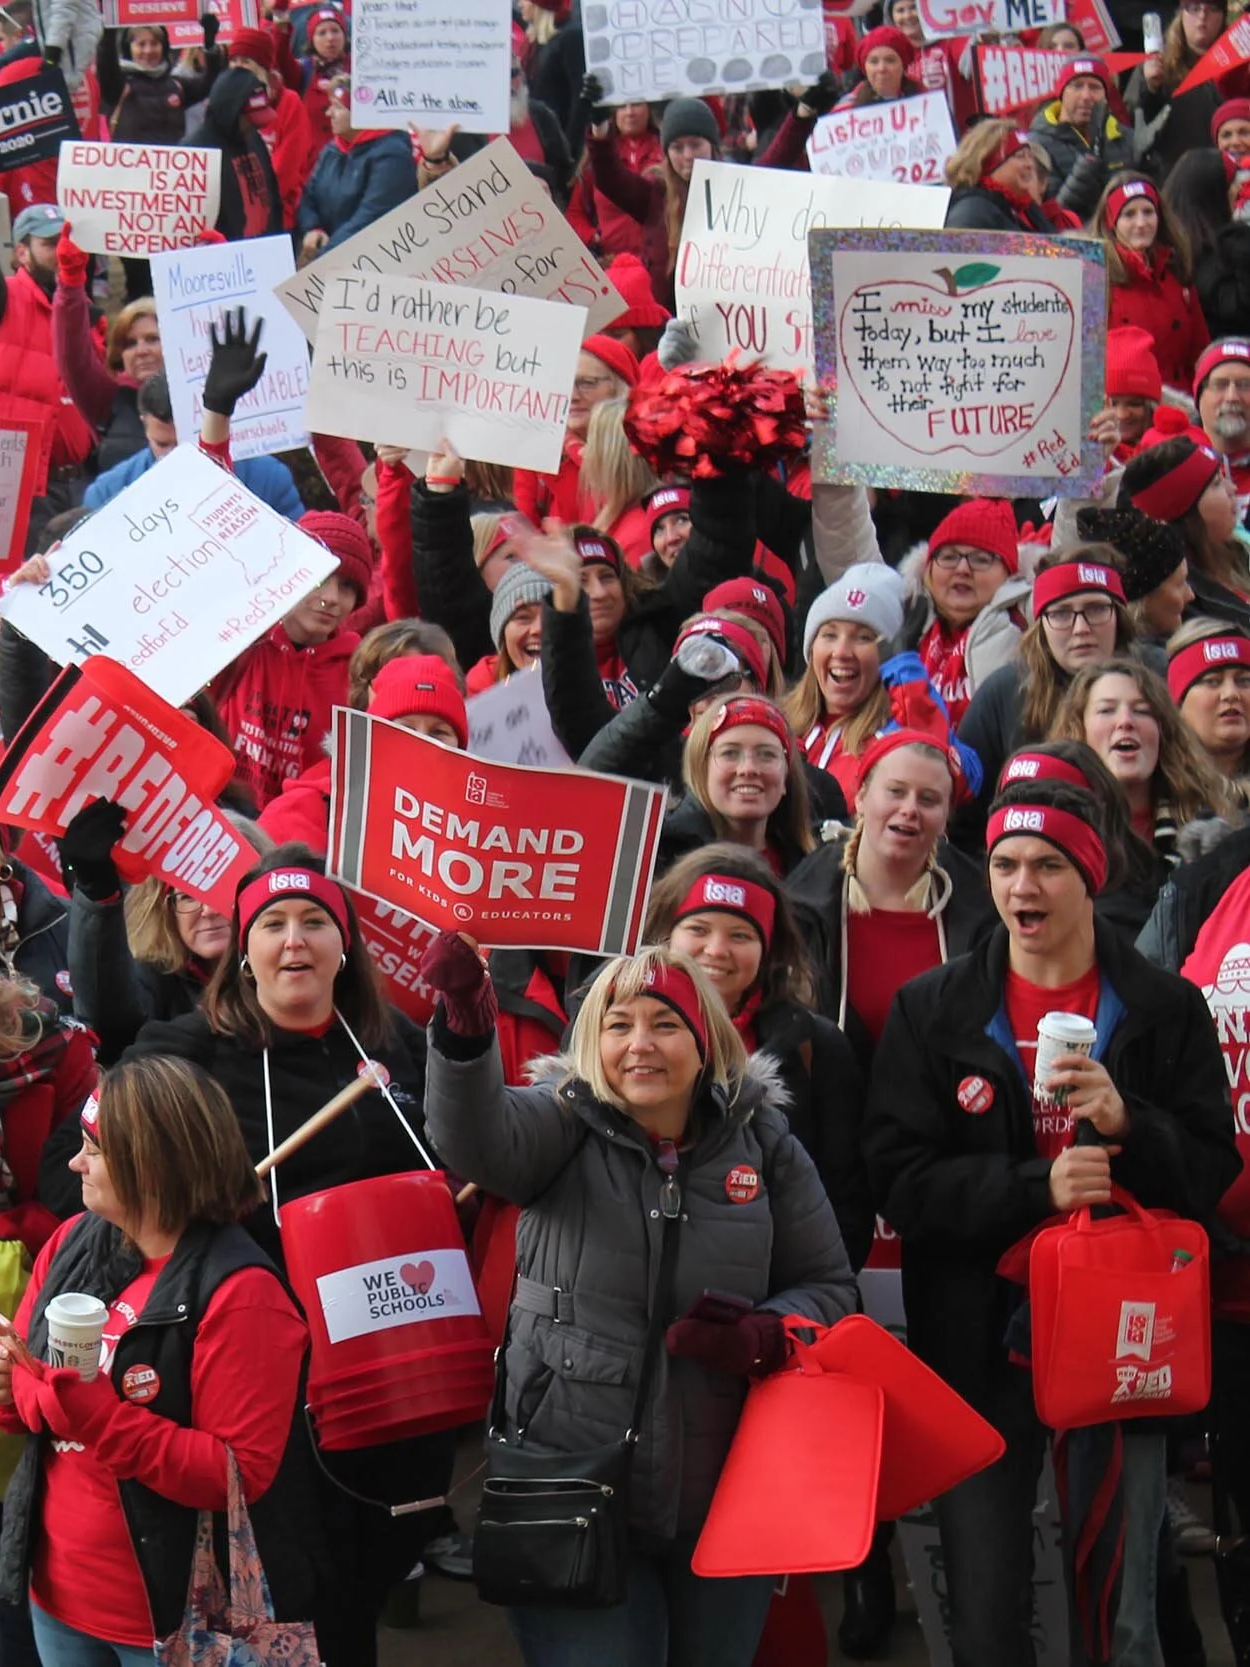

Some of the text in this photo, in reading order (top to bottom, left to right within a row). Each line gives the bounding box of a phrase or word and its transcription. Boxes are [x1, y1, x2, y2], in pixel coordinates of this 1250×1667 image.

[72, 146, 207, 171] EDUCATION
[150, 171, 207, 192] IS AN
[64, 188, 207, 213] INVESTMENT
[705, 178, 769, 250] Why
[118, 212, 207, 233] NOT AN
[168, 252, 257, 298] Mooresville
[514, 246, 565, 283] for
[332, 278, 512, 336] I'd rather be
[852, 291, 881, 313] I
[889, 297, 953, 318] miss
[961, 299, 995, 324] my
[715, 302, 767, 353] YOU
[853, 315, 1058, 351] today, but I love
[336, 322, 542, 377] TEACHING but
[858, 346, 1045, 371] them too much
[327, 354, 569, 425] this is IMPORTANT!
[870, 371, 1026, 402] to not fight for
[887, 393, 935, 414] their
[927, 402, 1035, 438] FUTURE
[123, 497, 180, 543] days
[202, 492, 243, 529] STUDENTS
[217, 505, 260, 541] REASON
[37, 550, 104, 608] 350
[132, 537, 223, 615] election
[217, 564, 314, 643] #RedStorm
[393, 786, 584, 855] DEMAND
[391, 819, 581, 902] MORE
[389, 867, 414, 889] FOR
[418, 882, 449, 909] KIDS
[481, 909, 572, 922] EDUCATORS
[362, 1271, 397, 1291] WE
[367, 1282, 428, 1305] PUBLIC
[369, 1294, 445, 1319] SCHOOLS
